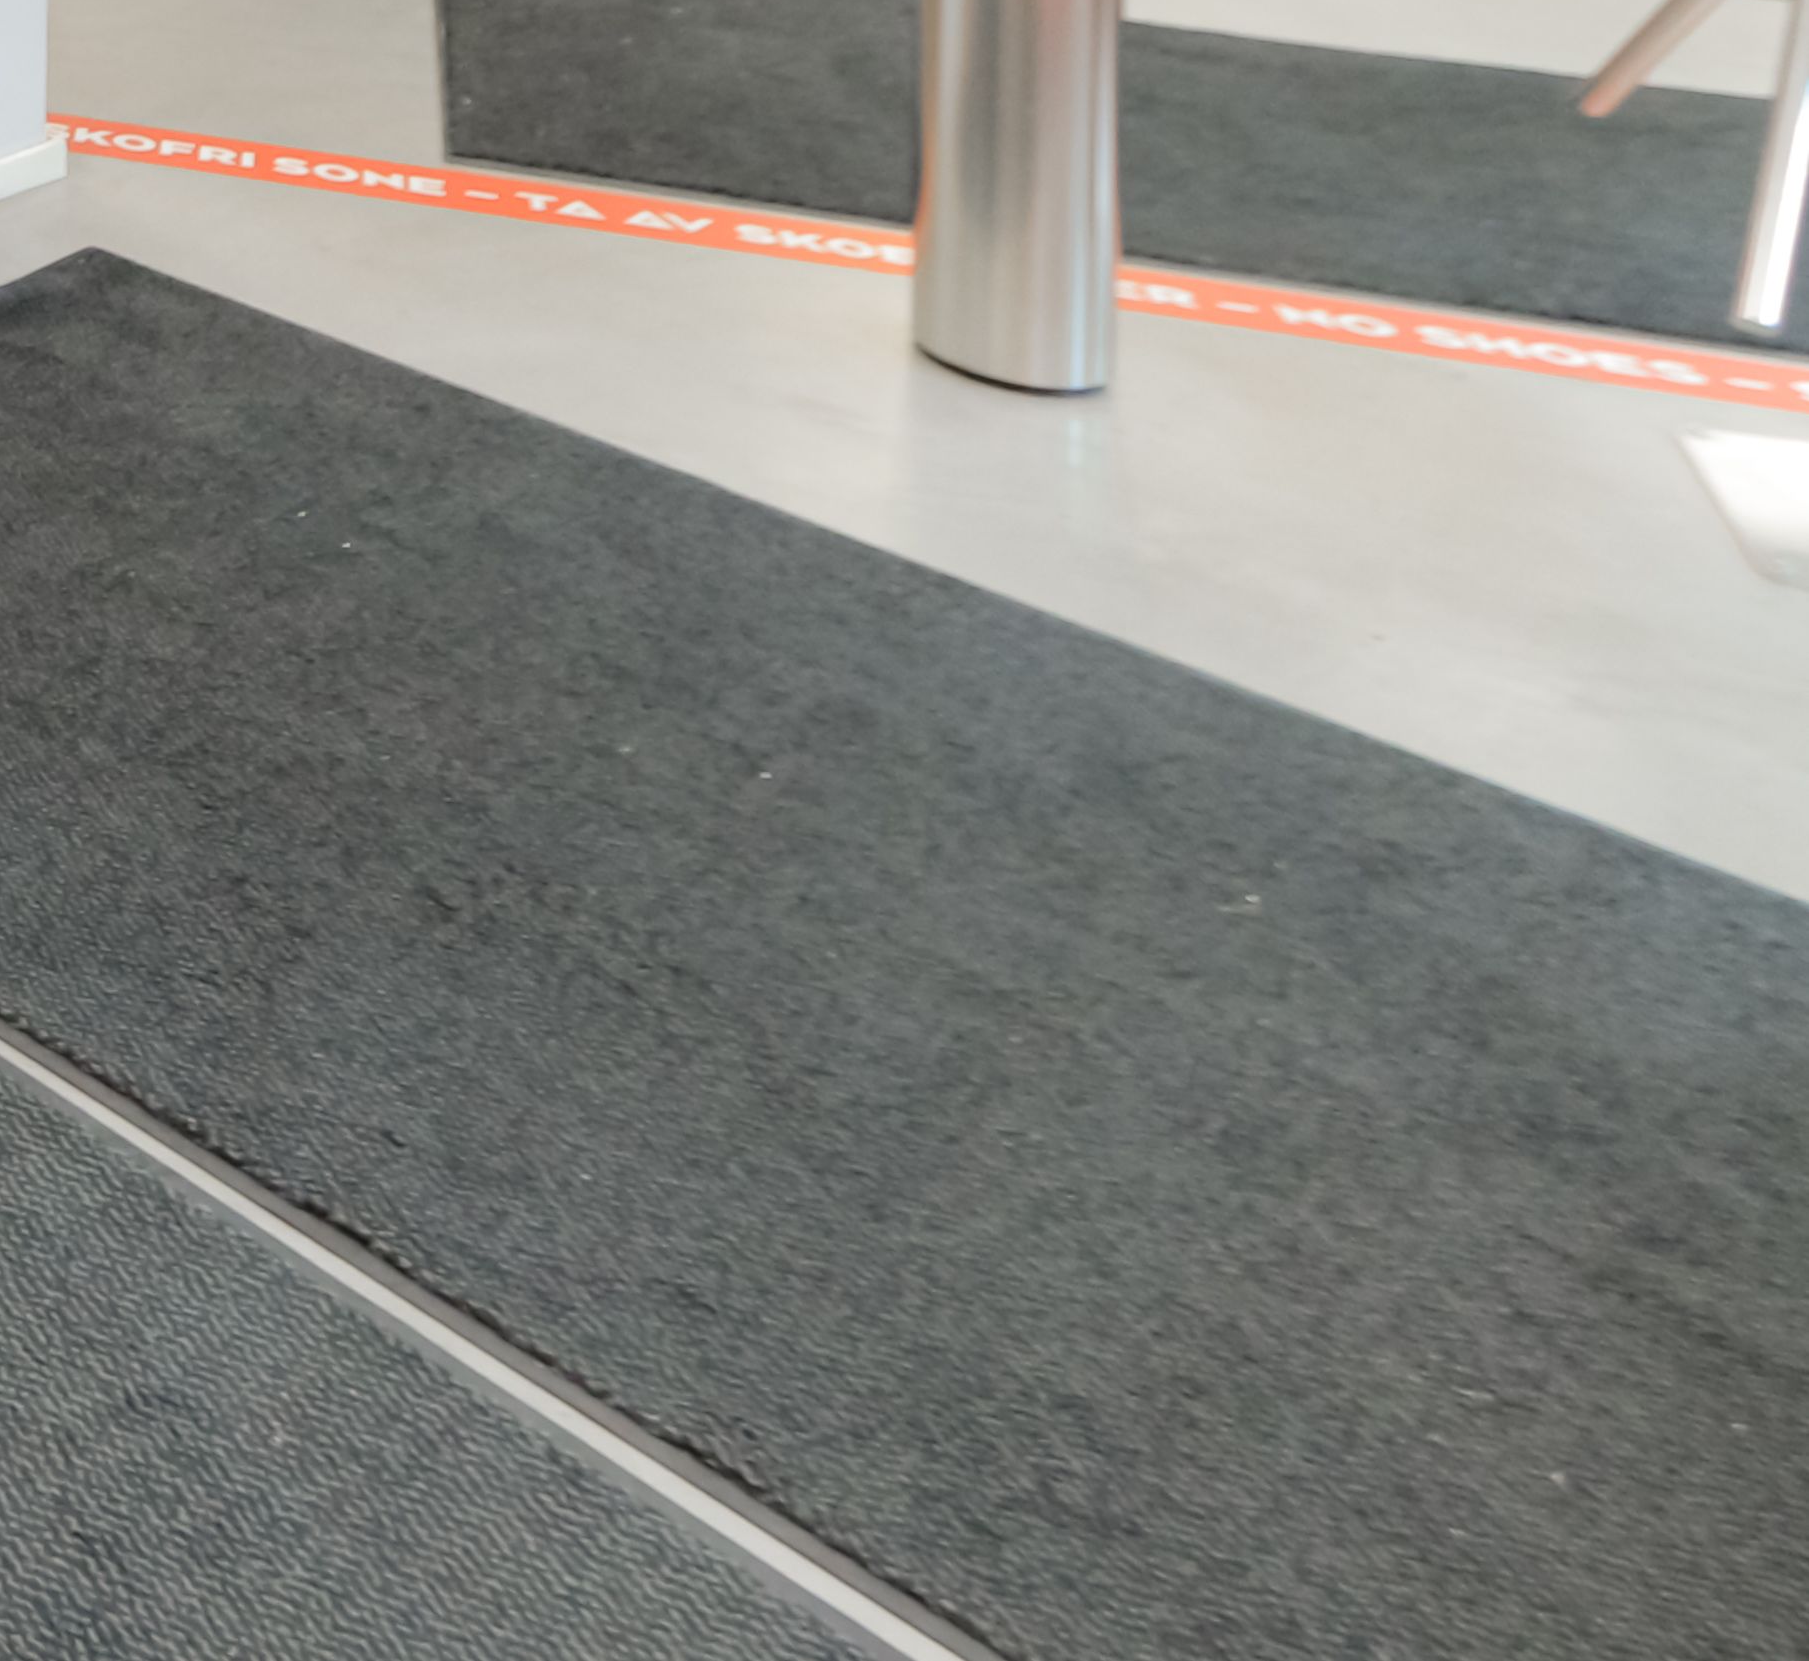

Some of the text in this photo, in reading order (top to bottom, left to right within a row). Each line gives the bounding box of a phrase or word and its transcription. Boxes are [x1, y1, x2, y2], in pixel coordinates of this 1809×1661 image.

[272, 146, 448, 198] SONE
[514, 191, 606, 221] TA
[624, 210, 713, 233] AV
[735, 224, 914, 266] SKOE
[1271, 303, 1398, 338] NO
[1414, 324, 1709, 385] SHOES
